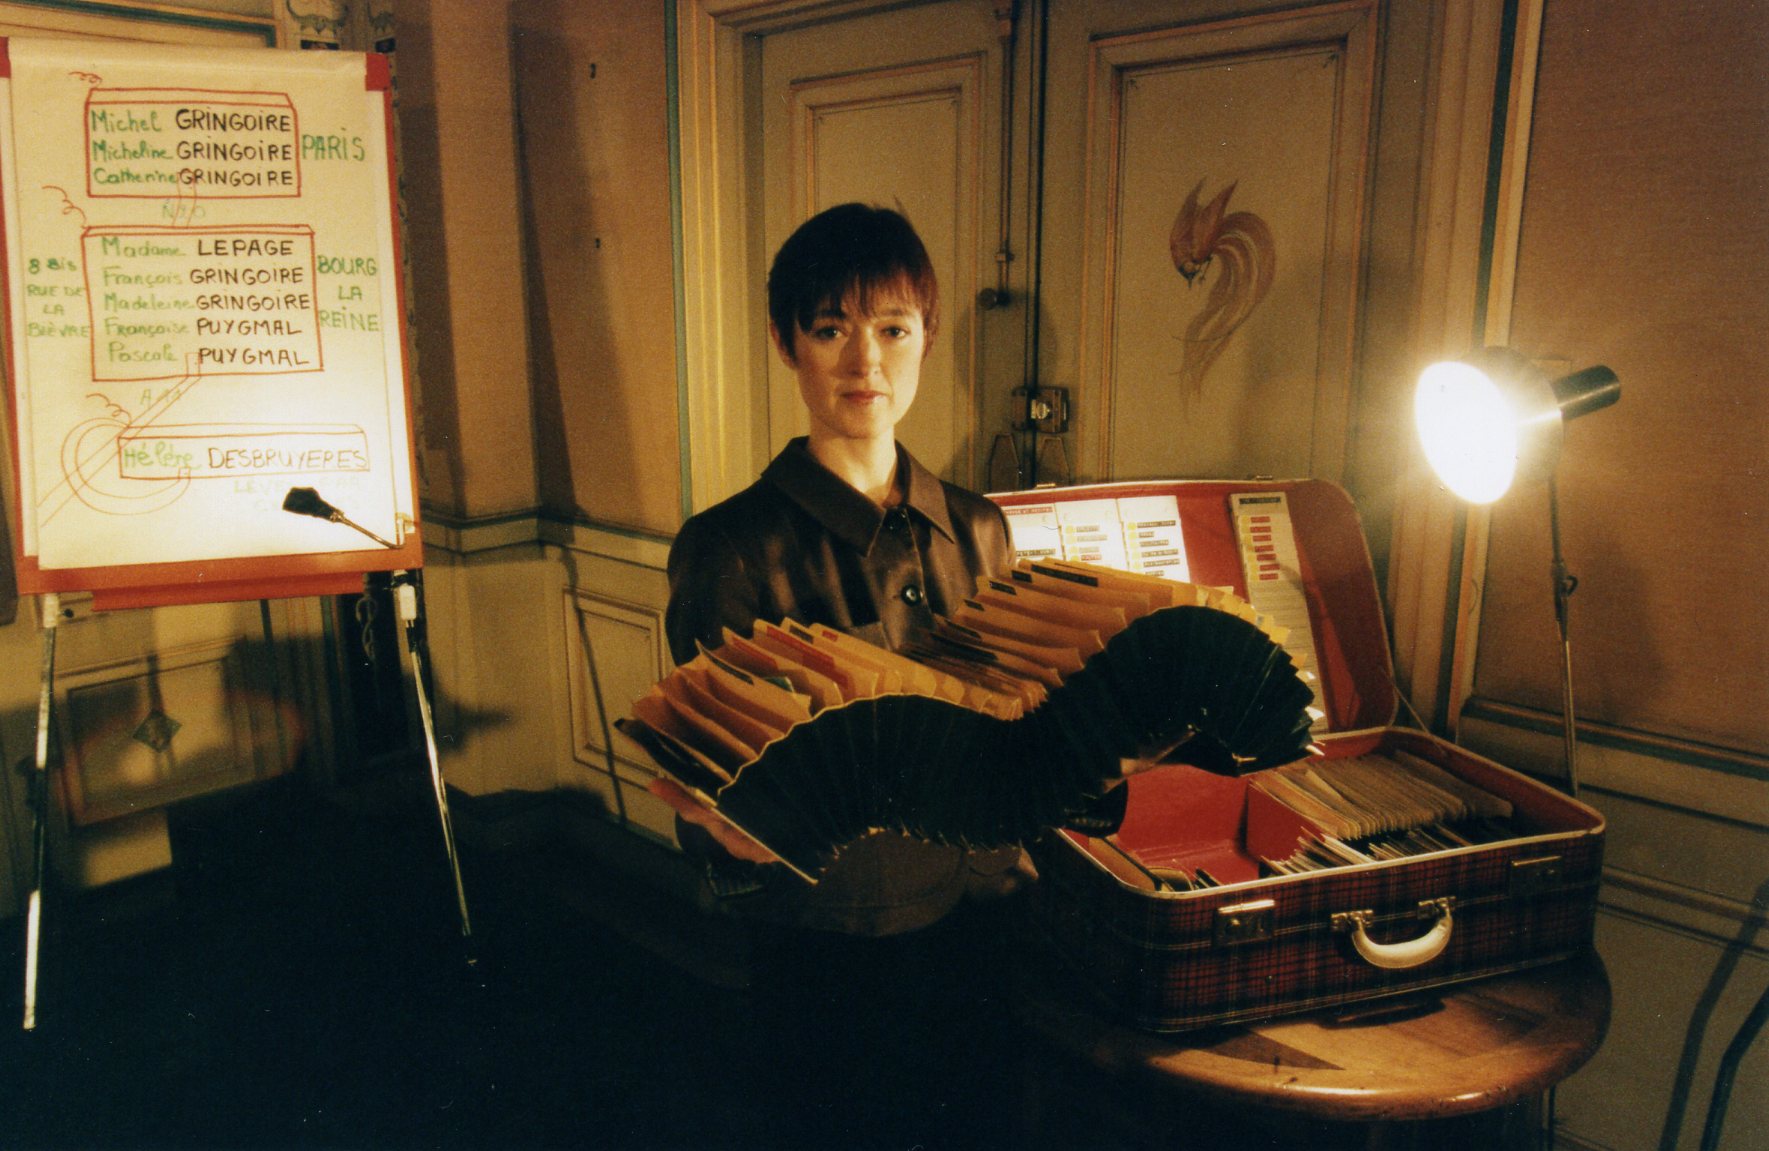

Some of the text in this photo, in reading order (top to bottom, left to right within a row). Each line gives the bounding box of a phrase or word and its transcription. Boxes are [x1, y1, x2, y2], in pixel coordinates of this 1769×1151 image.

[91, 109, 162, 133] Michel
[92, 139, 173, 161] Micheline
[93, 167, 293, 187] Catherine GRINGOIRE
[102, 236, 294, 257] Madame LEPAGE
[28, 257, 40, 275] 8
[317, 255, 378, 276] BOURG
[103, 265, 183, 288] François
[27, 284, 85, 297] RUE DE
[338, 285, 363, 301] LA
[43, 304, 65, 316] LA
[104, 293, 197, 312] Madeleine
[104, 316, 303, 338] Françoise PUYGMAL
[108, 340, 310, 367] Pascale PUYGMAL
